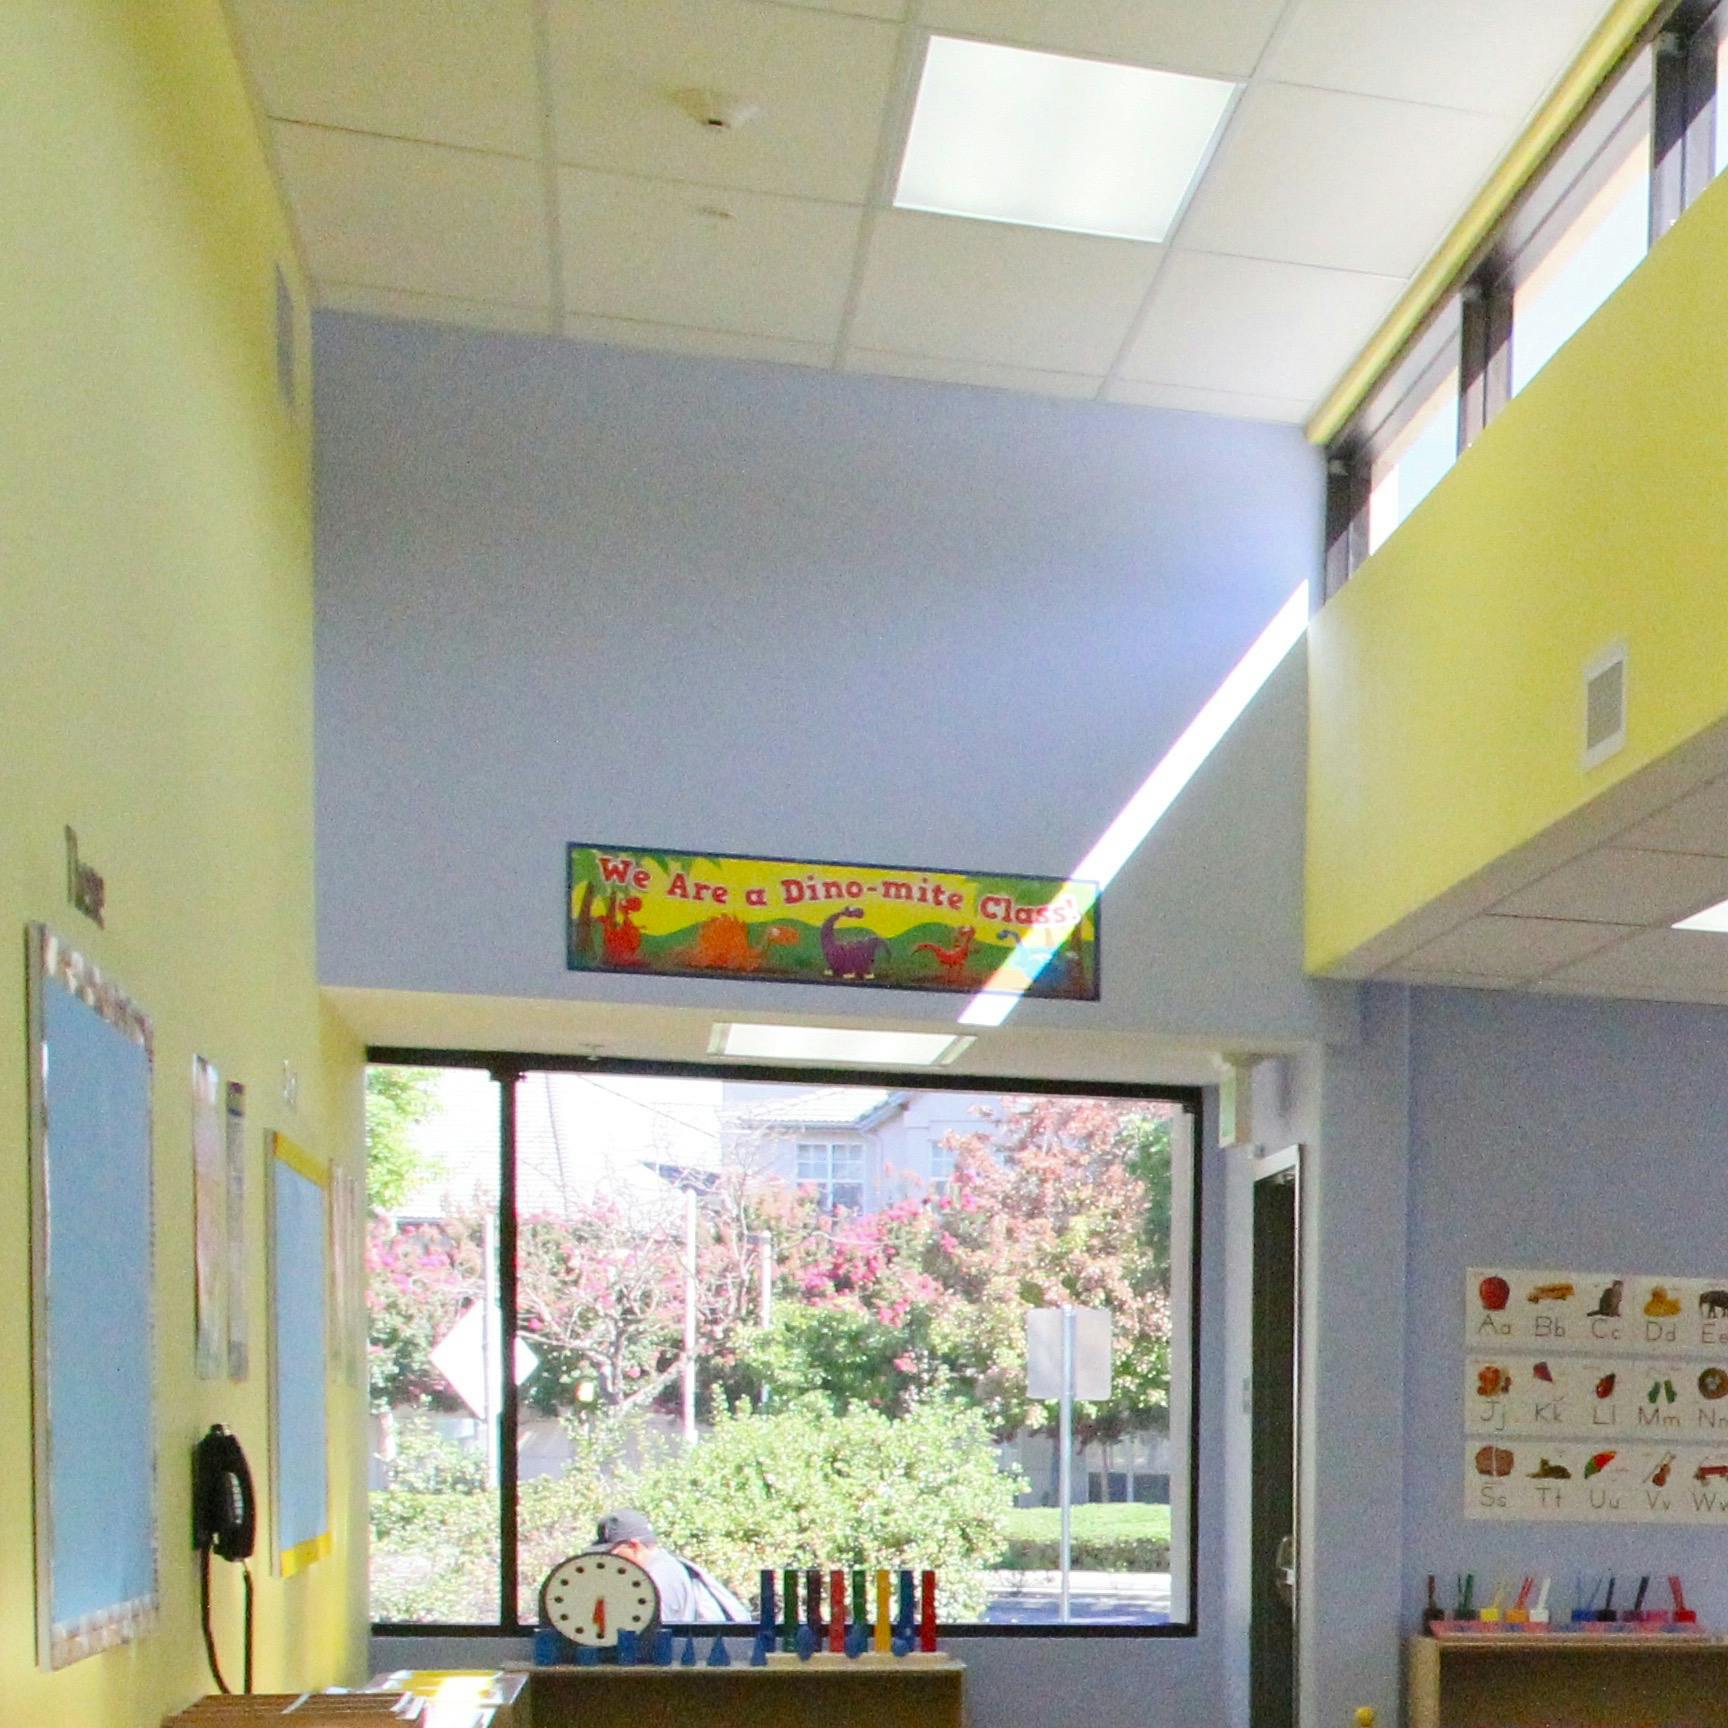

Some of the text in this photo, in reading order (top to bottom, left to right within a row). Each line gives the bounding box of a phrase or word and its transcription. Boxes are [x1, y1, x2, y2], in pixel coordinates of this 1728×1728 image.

[596, 856, 1081, 926] We Are a Dino-mite Class!
[1478, 1314, 1512, 1337] Aa
[1534, 1317, 1566, 1338] Bb
[1646, 1321, 1678, 1342] Dd
[1480, 1401, 1508, 1432] Jj
[1638, 1407, 1680, 1428] Mm
